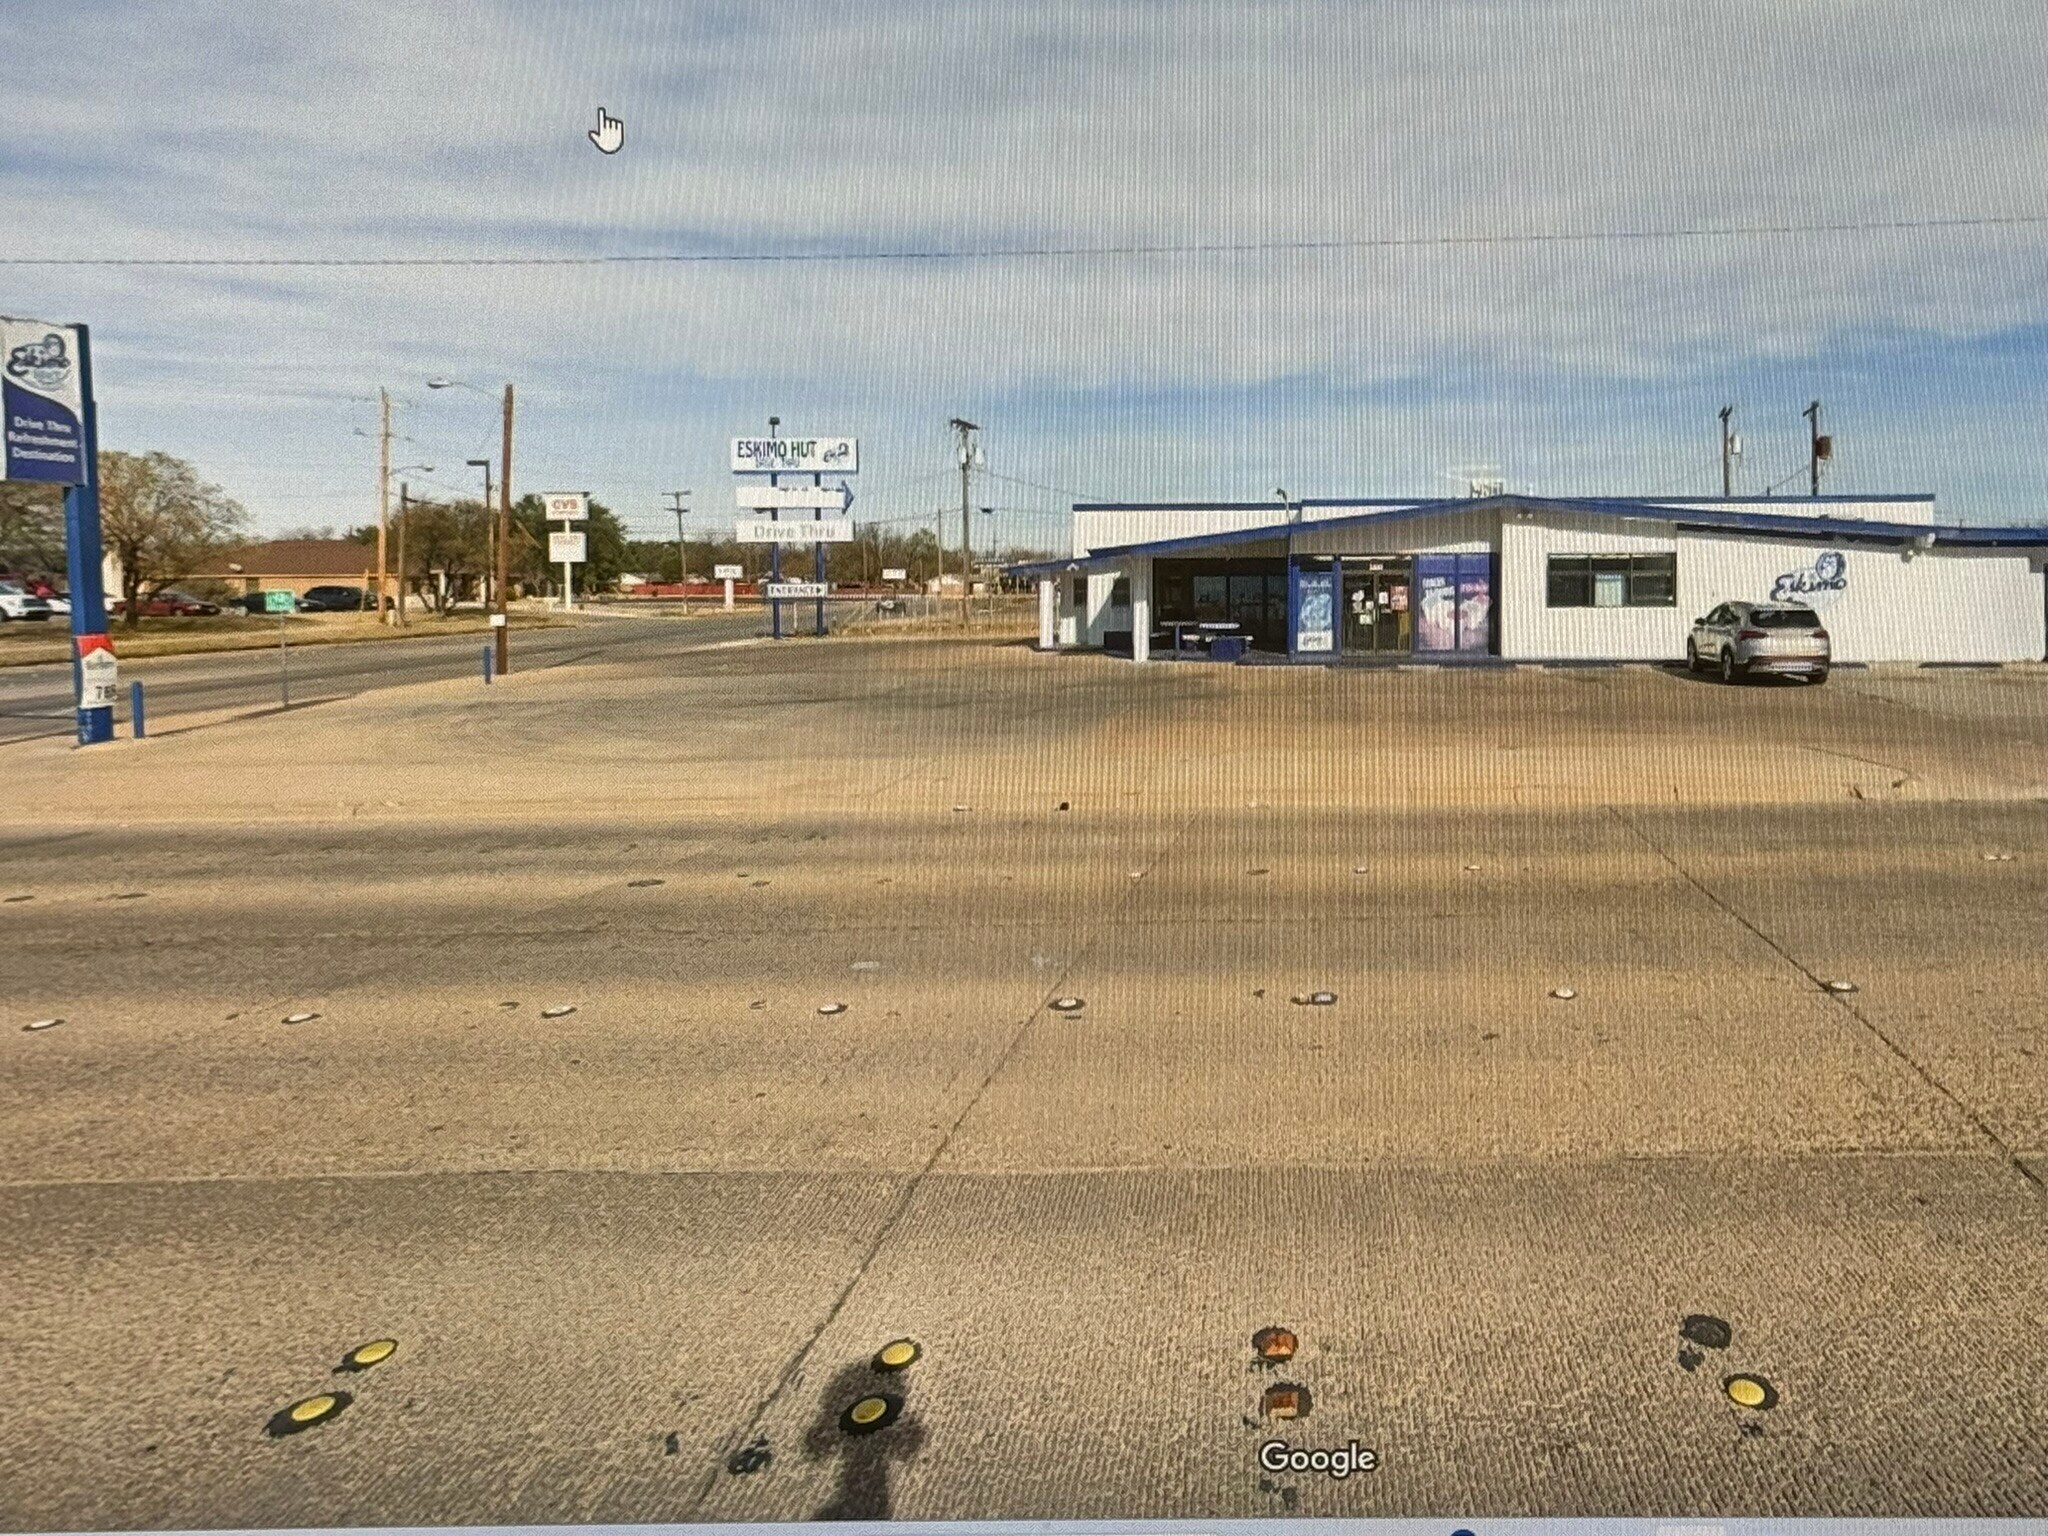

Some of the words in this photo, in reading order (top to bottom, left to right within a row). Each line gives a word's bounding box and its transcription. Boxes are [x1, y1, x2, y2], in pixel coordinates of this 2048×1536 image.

[737, 440, 787, 460] ESKIMO
[791, 441, 817, 458] HUT
[754, 525, 795, 539] Drive
[800, 524, 836, 539] Thru
